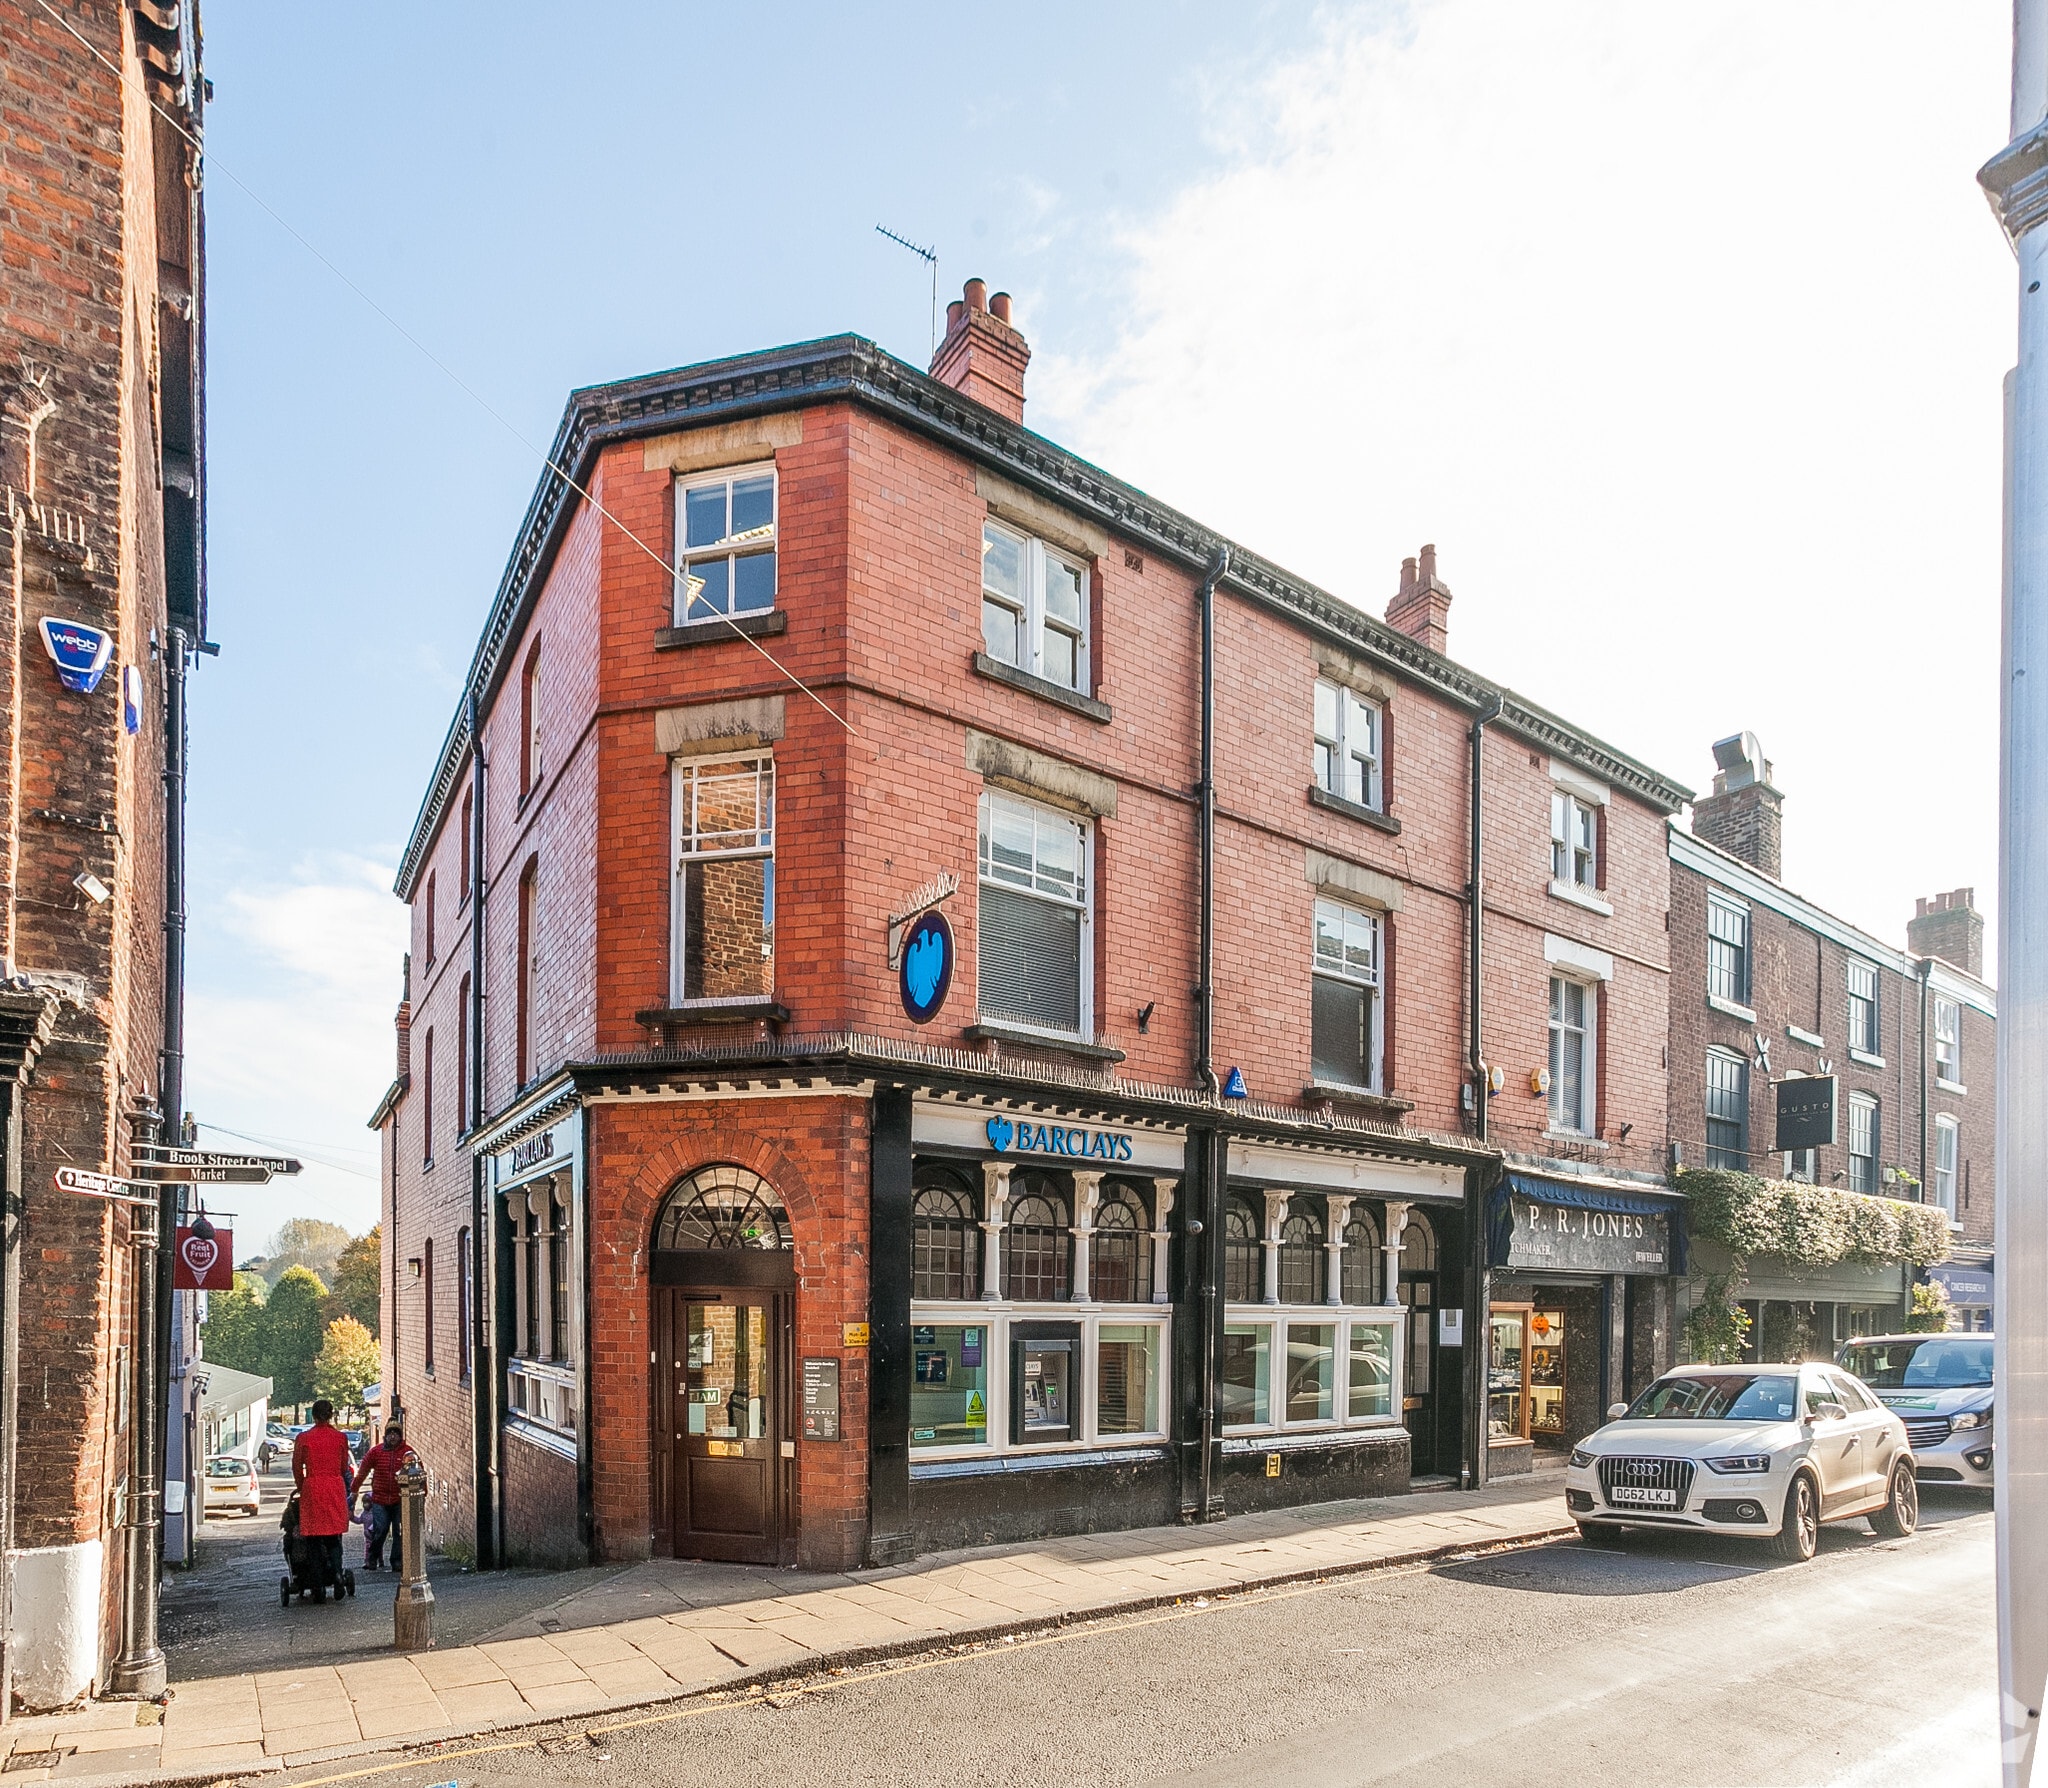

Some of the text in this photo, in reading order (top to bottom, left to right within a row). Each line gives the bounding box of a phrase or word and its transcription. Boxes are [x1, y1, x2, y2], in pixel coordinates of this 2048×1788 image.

[51, 632, 98, 651] webb
[1780, 1102, 1830, 1114] GUSTO
[1018, 1123, 1133, 1161] BARCLAYS
[169, 1150, 206, 1165] Brook
[208, 1154, 245, 1166] Street
[75, 1173, 130, 1195] Heritage Centre
[190, 1168, 226, 1181] Market
[1529, 1205, 1643, 1239] P. R. JONES
[1511, 1241, 1664, 1263] TCHMAKER JEWELLER
[1616, 1488, 1671, 1502] DG62 LKJ
